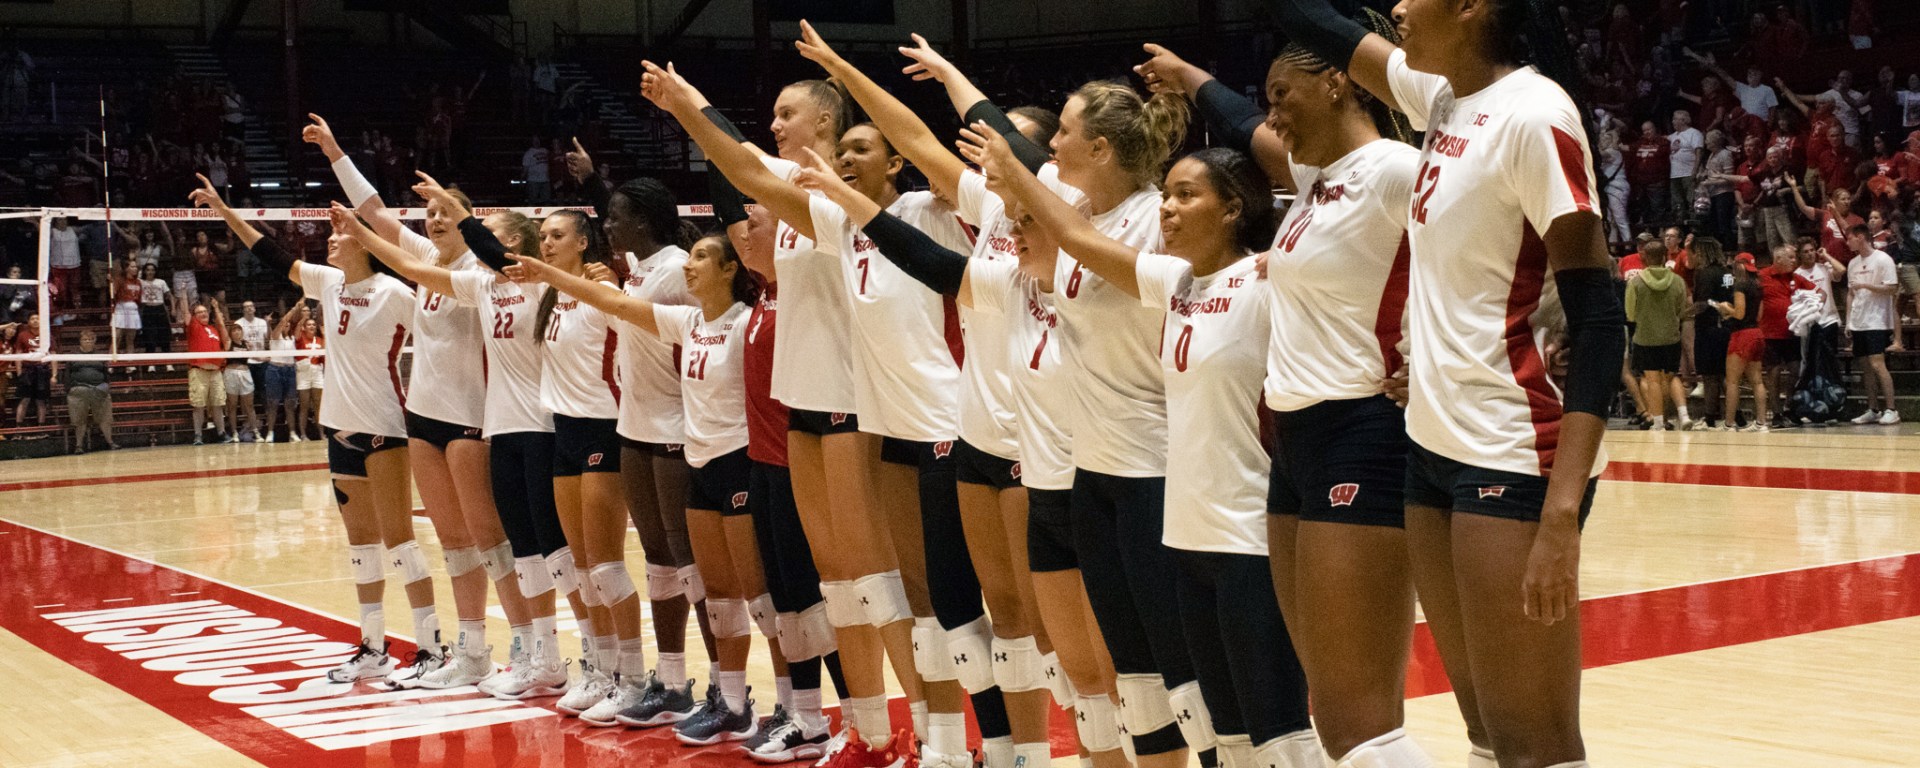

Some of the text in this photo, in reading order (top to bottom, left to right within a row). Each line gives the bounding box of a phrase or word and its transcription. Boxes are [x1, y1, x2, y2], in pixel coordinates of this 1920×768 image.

[141, 209, 221, 218] WISCONSIN BADGE
[290, 209, 331, 218] WISCONS
[690, 205, 712, 214] WISCO
[1277, 207, 1314, 253] 10
[857, 257, 869, 295] 7
[1066, 260, 1083, 299] 6
[423, 290, 442, 312] 13
[338, 309, 351, 335] 9
[493, 311, 514, 339] 22
[1174, 324, 1193, 372] 0
[687, 350, 709, 381] 21
